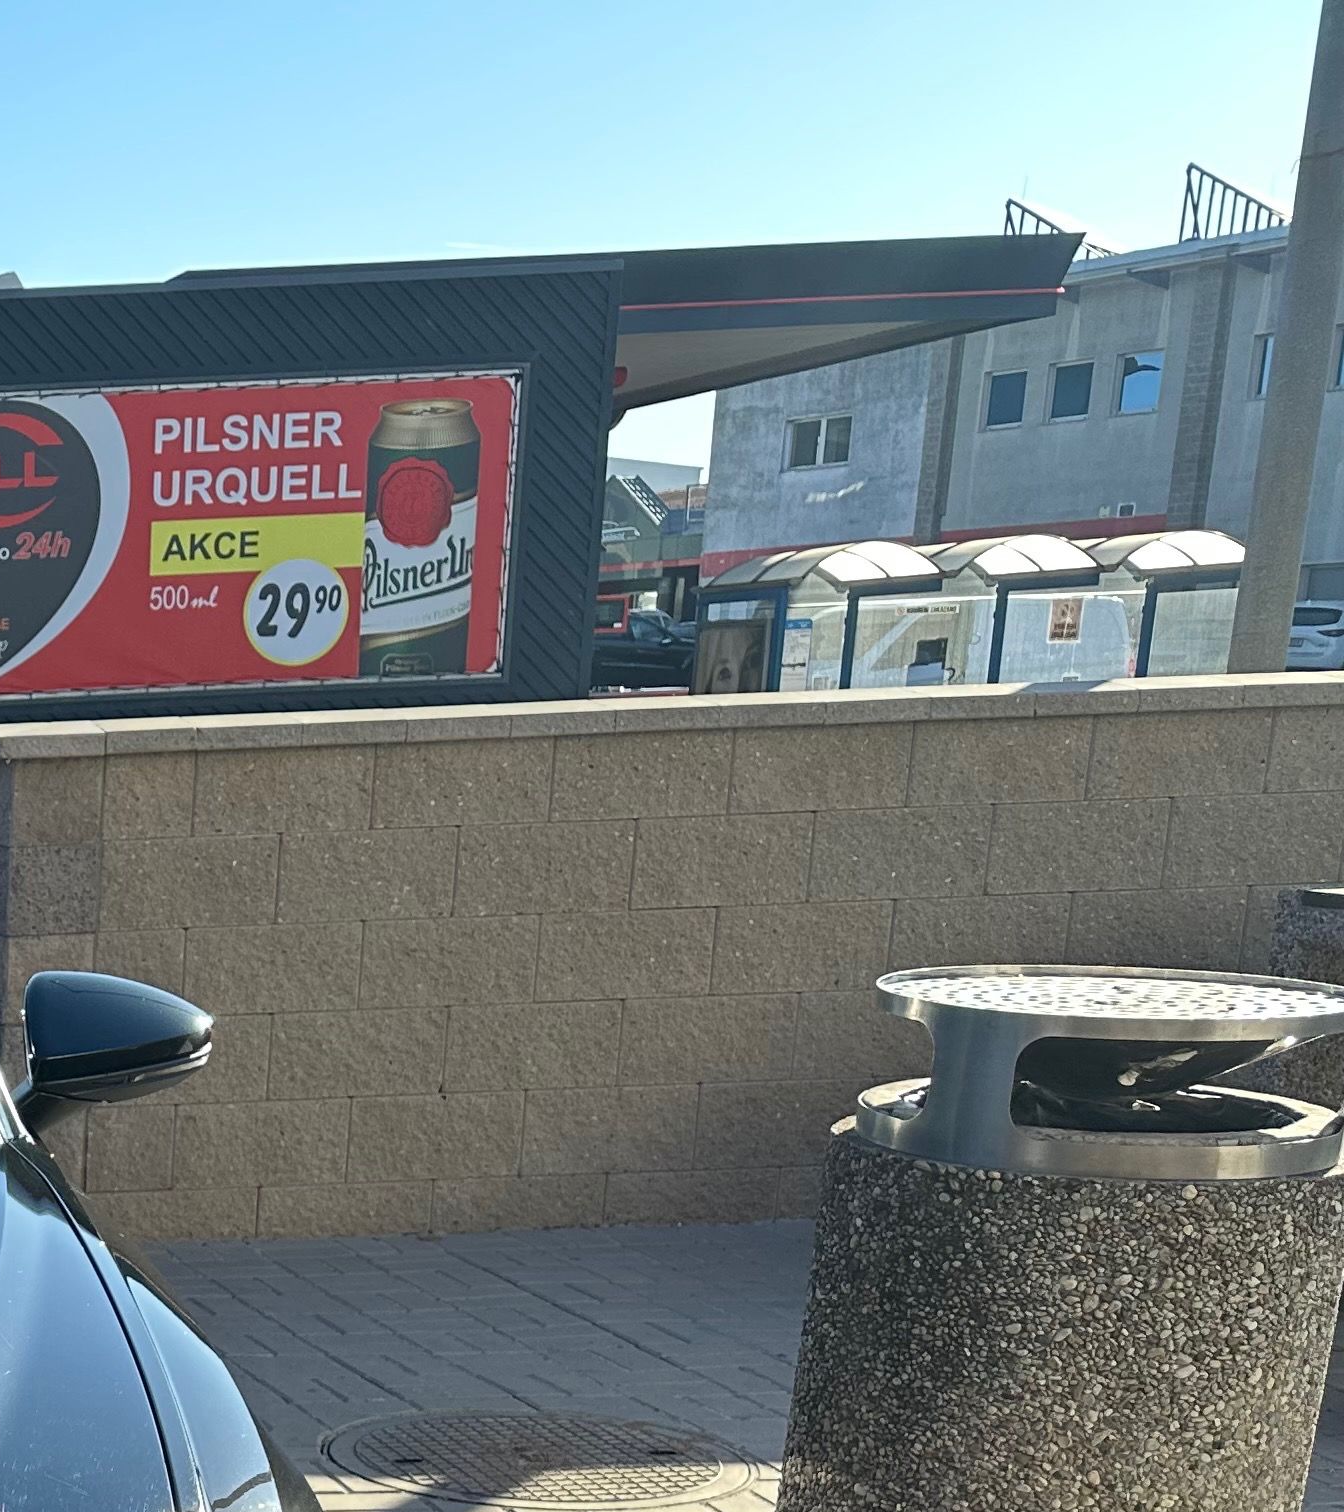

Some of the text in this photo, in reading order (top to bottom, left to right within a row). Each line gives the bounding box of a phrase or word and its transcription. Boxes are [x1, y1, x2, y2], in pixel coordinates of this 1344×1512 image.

[154, 411, 343, 454] PILSNER
[153, 463, 362, 507] URQUELL
[12, 531, 72, 560] 24h
[162, 530, 259, 562] AKCE
[362, 537, 449, 614] Pilsner
